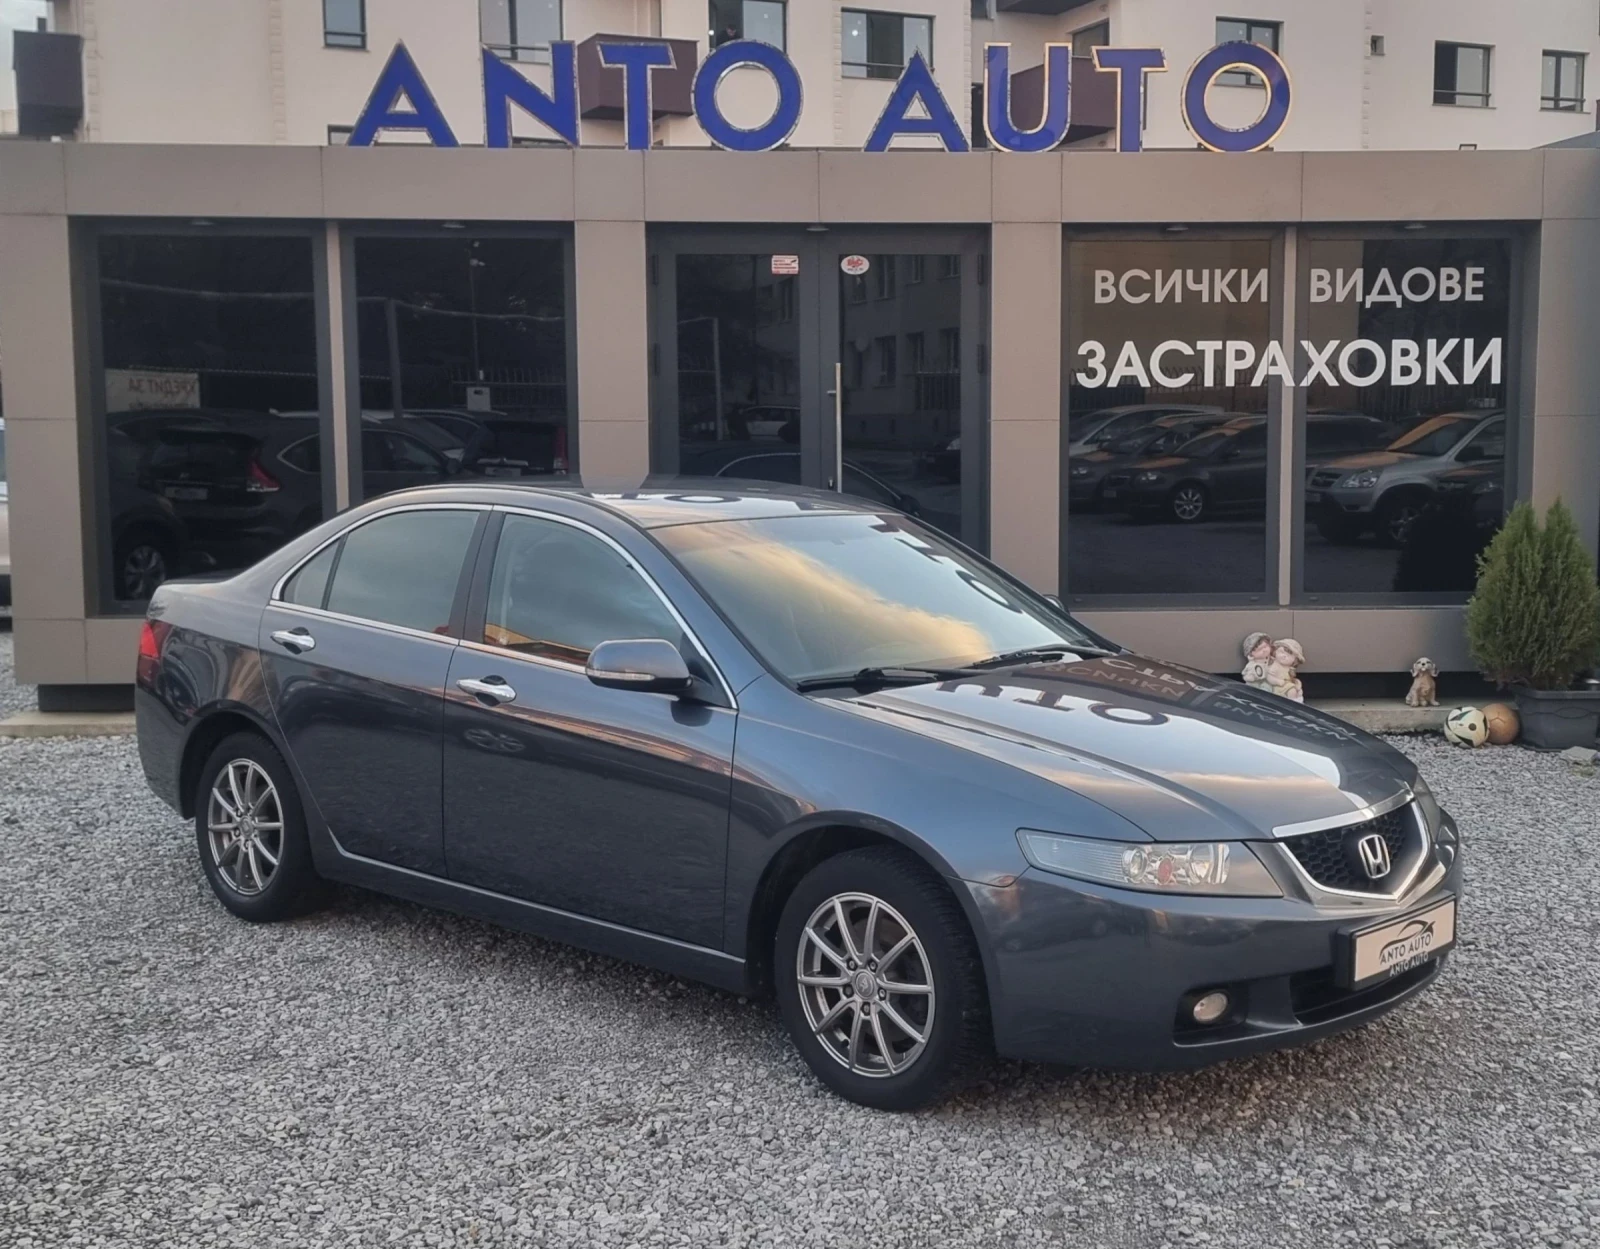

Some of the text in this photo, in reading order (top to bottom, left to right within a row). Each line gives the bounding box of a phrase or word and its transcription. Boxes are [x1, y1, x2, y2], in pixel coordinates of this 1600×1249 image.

[347, 38, 1292, 152] ANTO AUTO
[1093, 266, 1485, 309] ВСИЧКИ ВИДОВЕ
[1075, 337, 1502, 389] ЗАСТРАХОВКИ
[1380, 933, 1431, 965] ANTO AUTO
[1389, 951, 1429, 977] ANTO AUTO
